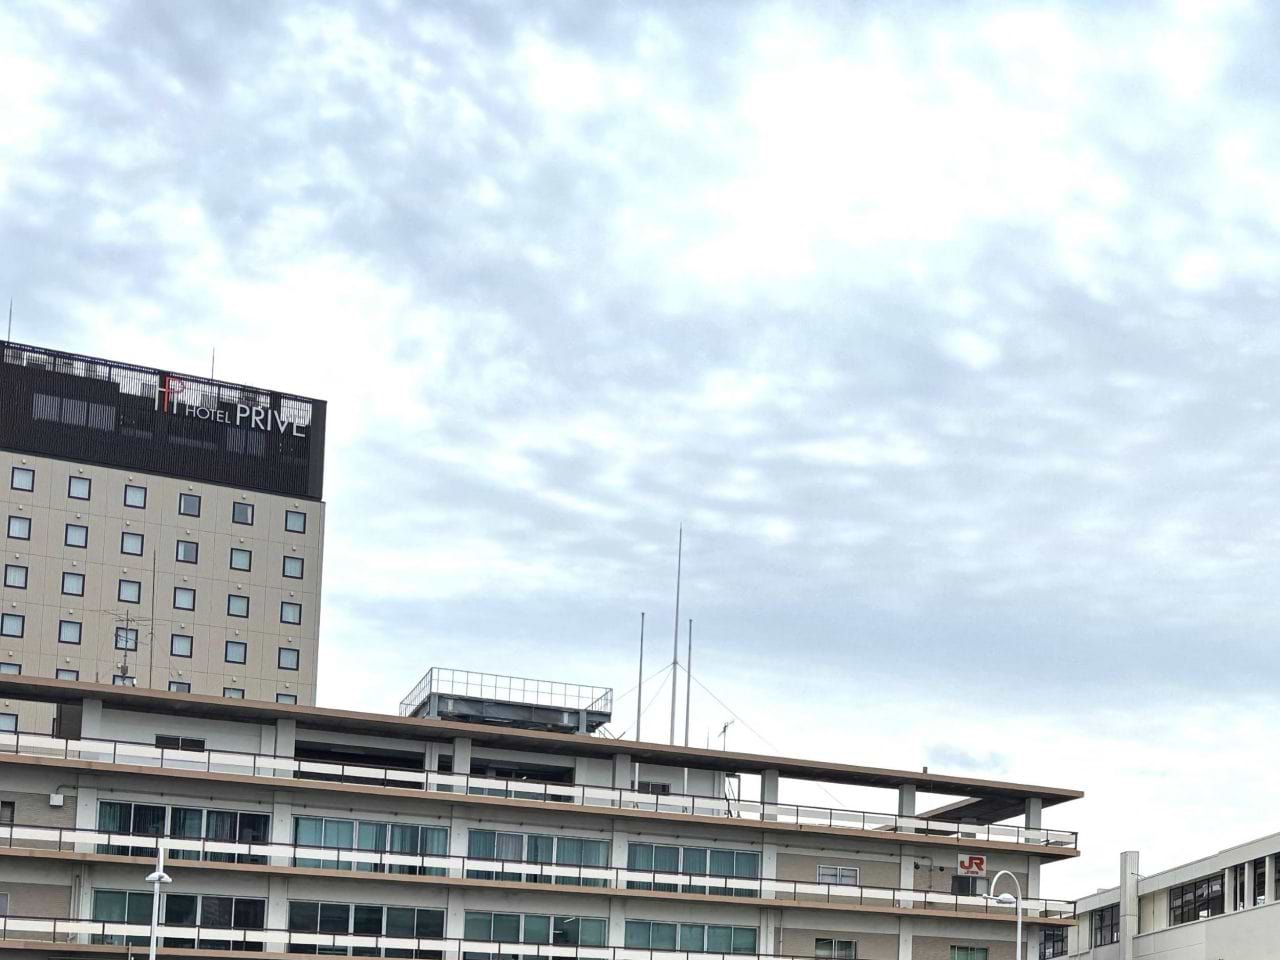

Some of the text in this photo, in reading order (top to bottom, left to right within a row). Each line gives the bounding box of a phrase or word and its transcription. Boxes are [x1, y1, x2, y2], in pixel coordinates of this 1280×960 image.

[185, 403, 306, 438] HOTEL PRIVE
[960, 856, 984, 871] JR
